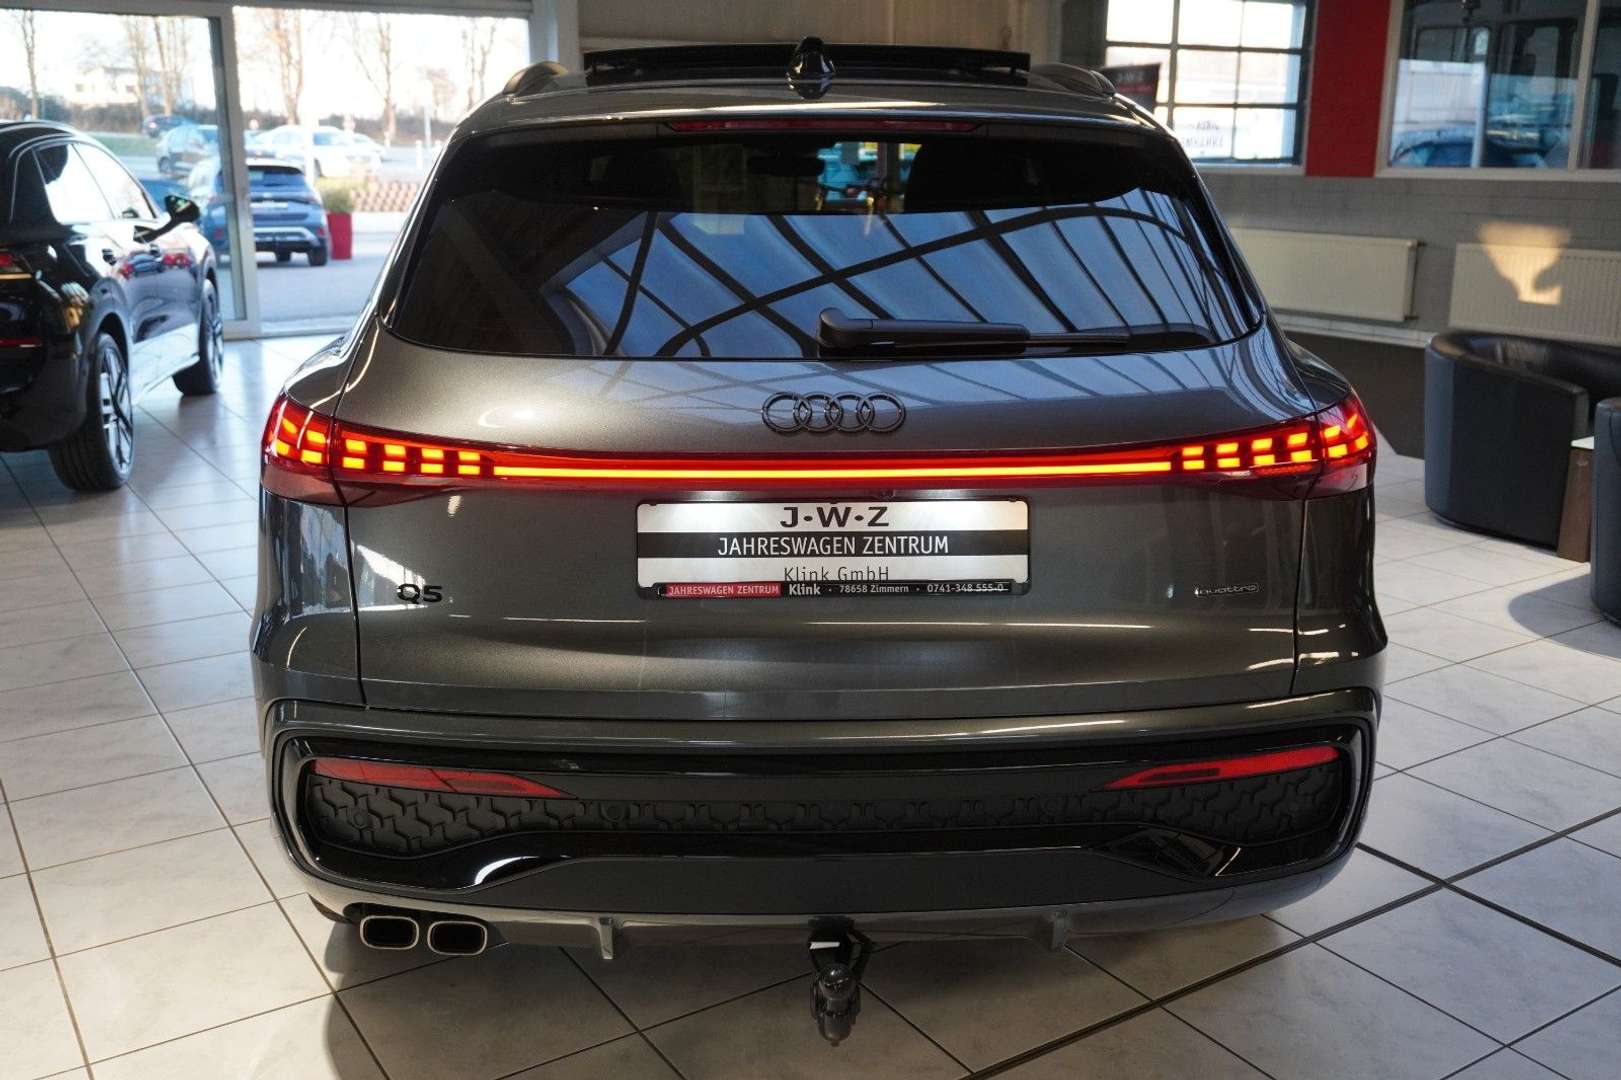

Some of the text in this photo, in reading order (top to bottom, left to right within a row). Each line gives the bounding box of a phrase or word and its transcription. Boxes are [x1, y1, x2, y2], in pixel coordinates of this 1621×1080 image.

[718, 535, 949, 556] JAHRESWAGEN ZENTRUM
[784, 566, 889, 582] Klink GmbH
[397, 583, 442, 604] Q5
[669, 585, 734, 596] JAHRESWAGEN
[737, 584, 780, 595] ZENTRUM
[789, 583, 821, 596] Klink
[839, 583, 868, 593] 78658
[870, 583, 910, 593] Zimmern
